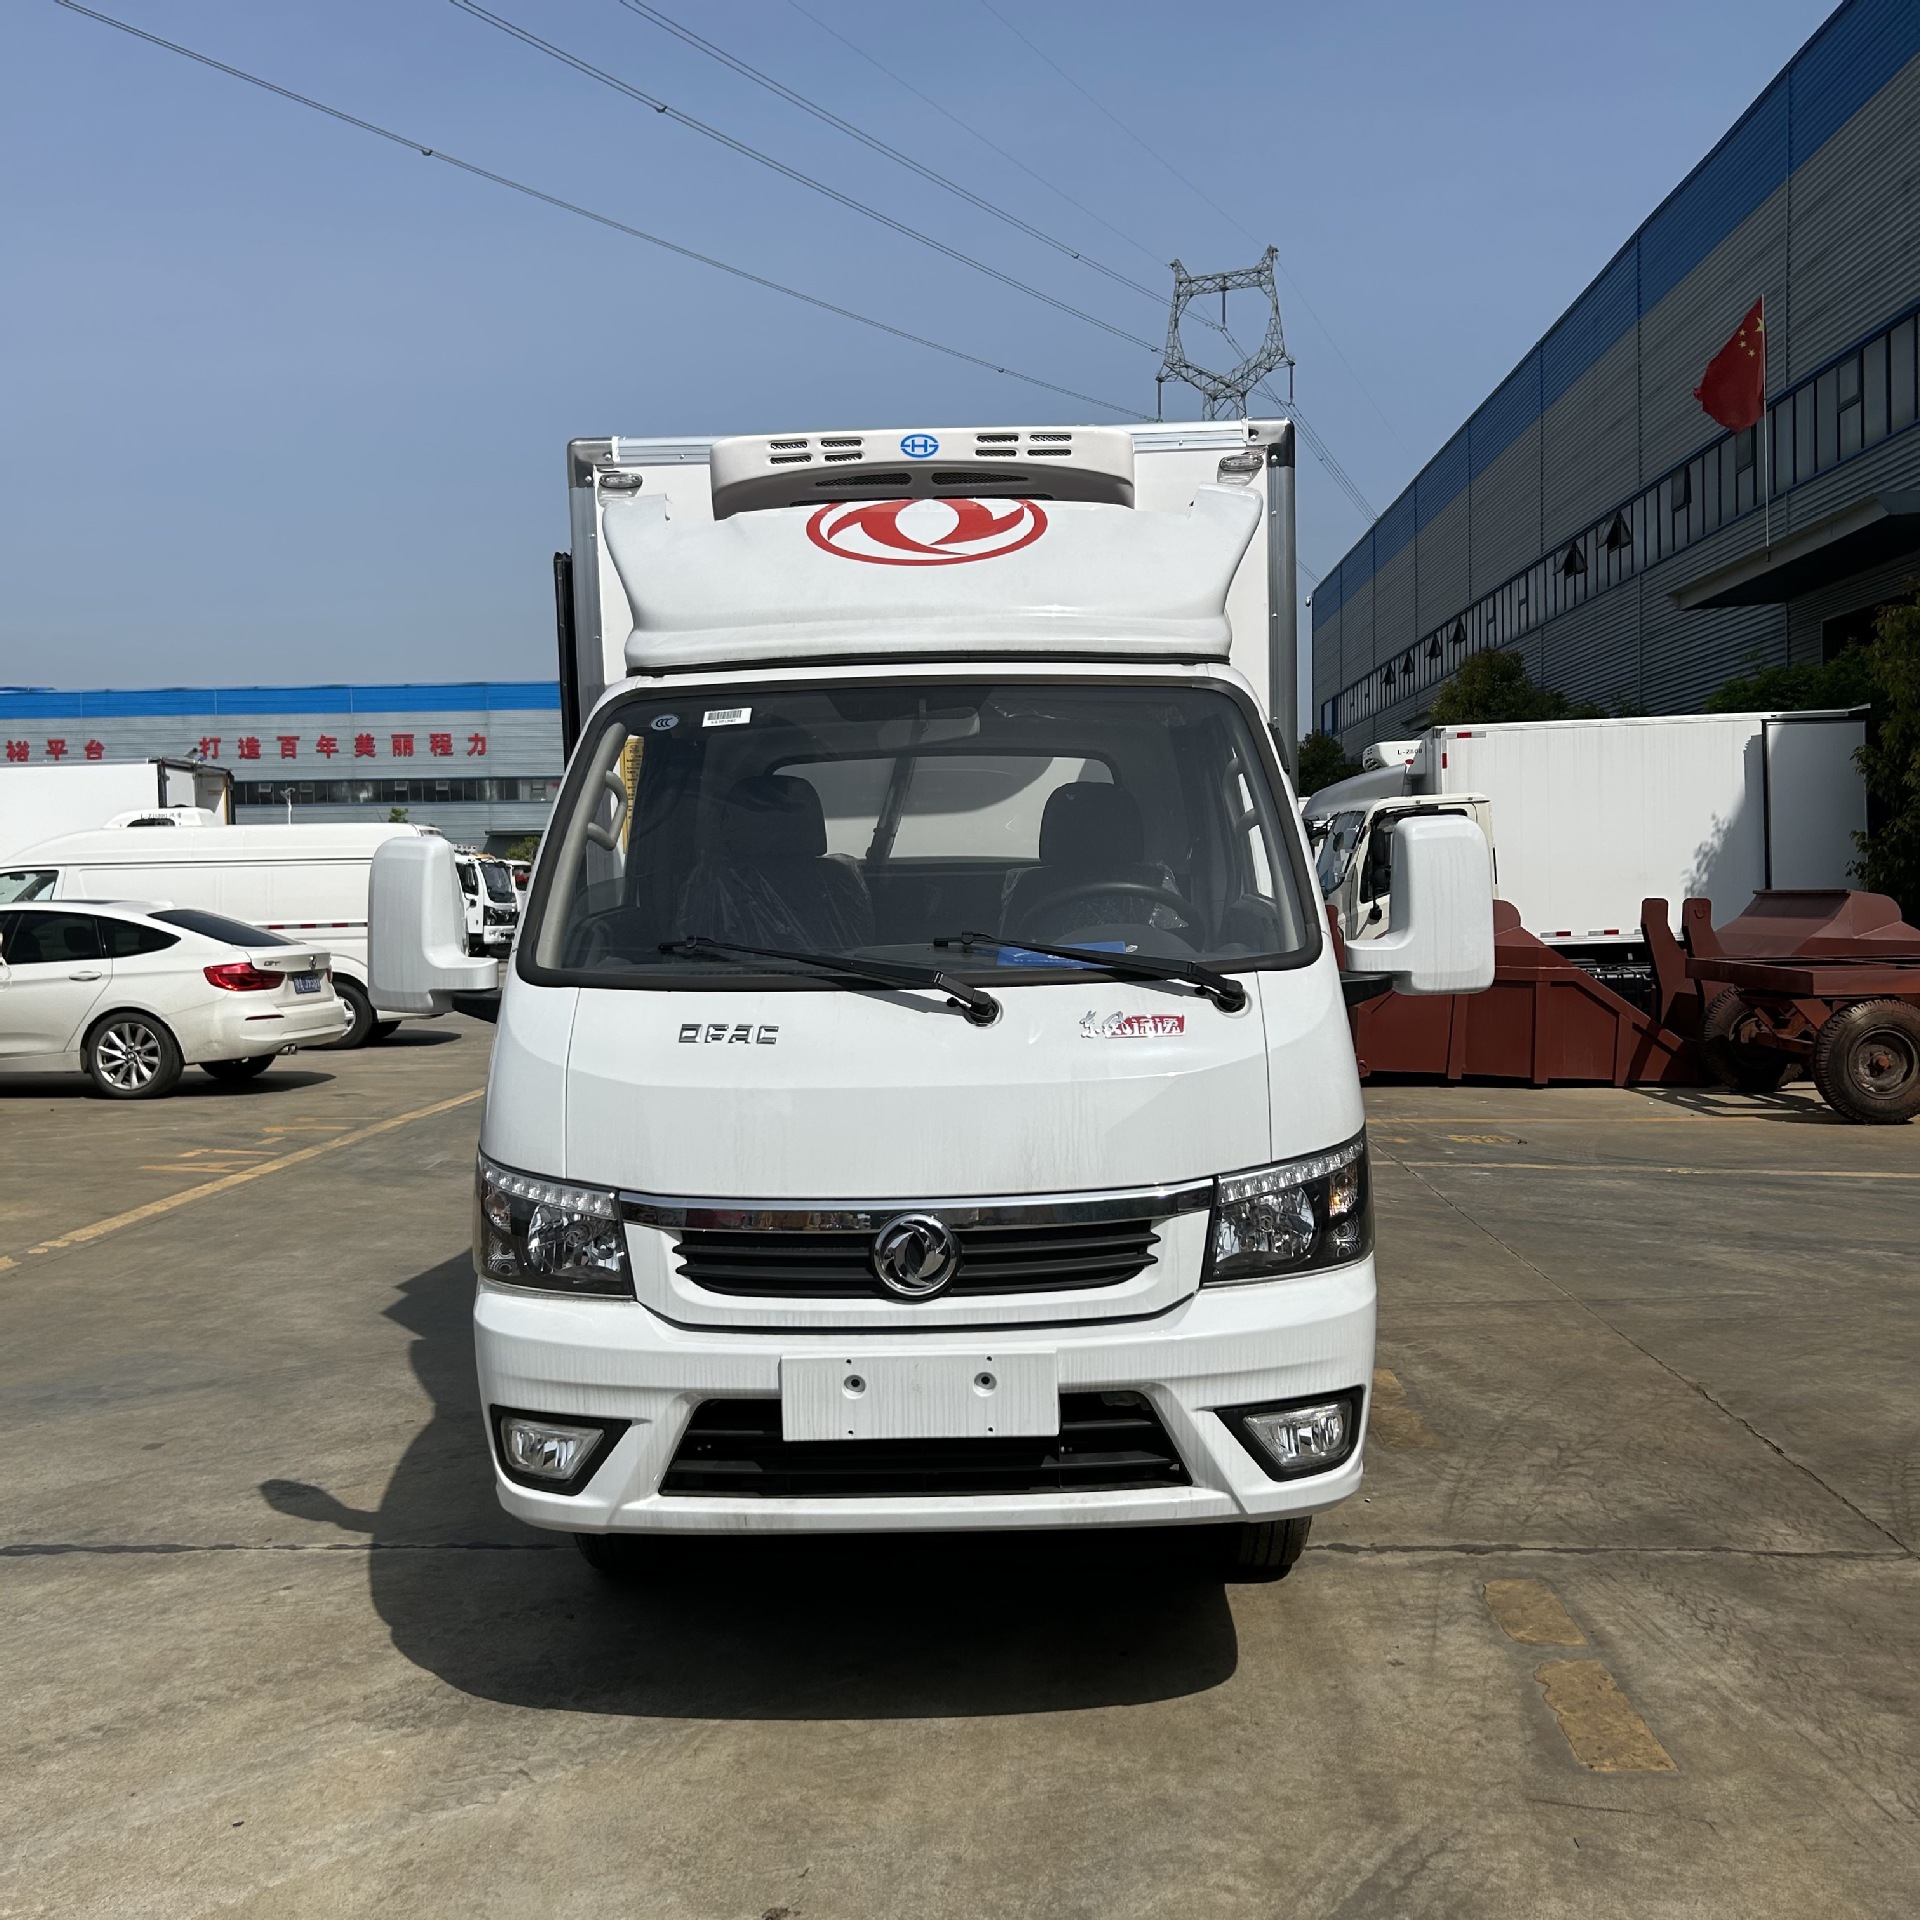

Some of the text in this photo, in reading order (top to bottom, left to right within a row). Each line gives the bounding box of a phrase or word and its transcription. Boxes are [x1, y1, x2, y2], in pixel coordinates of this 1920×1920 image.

[199, 733, 488, 760] 打造百年美丽程力
[678, 1023, 779, 1045] DFAC
